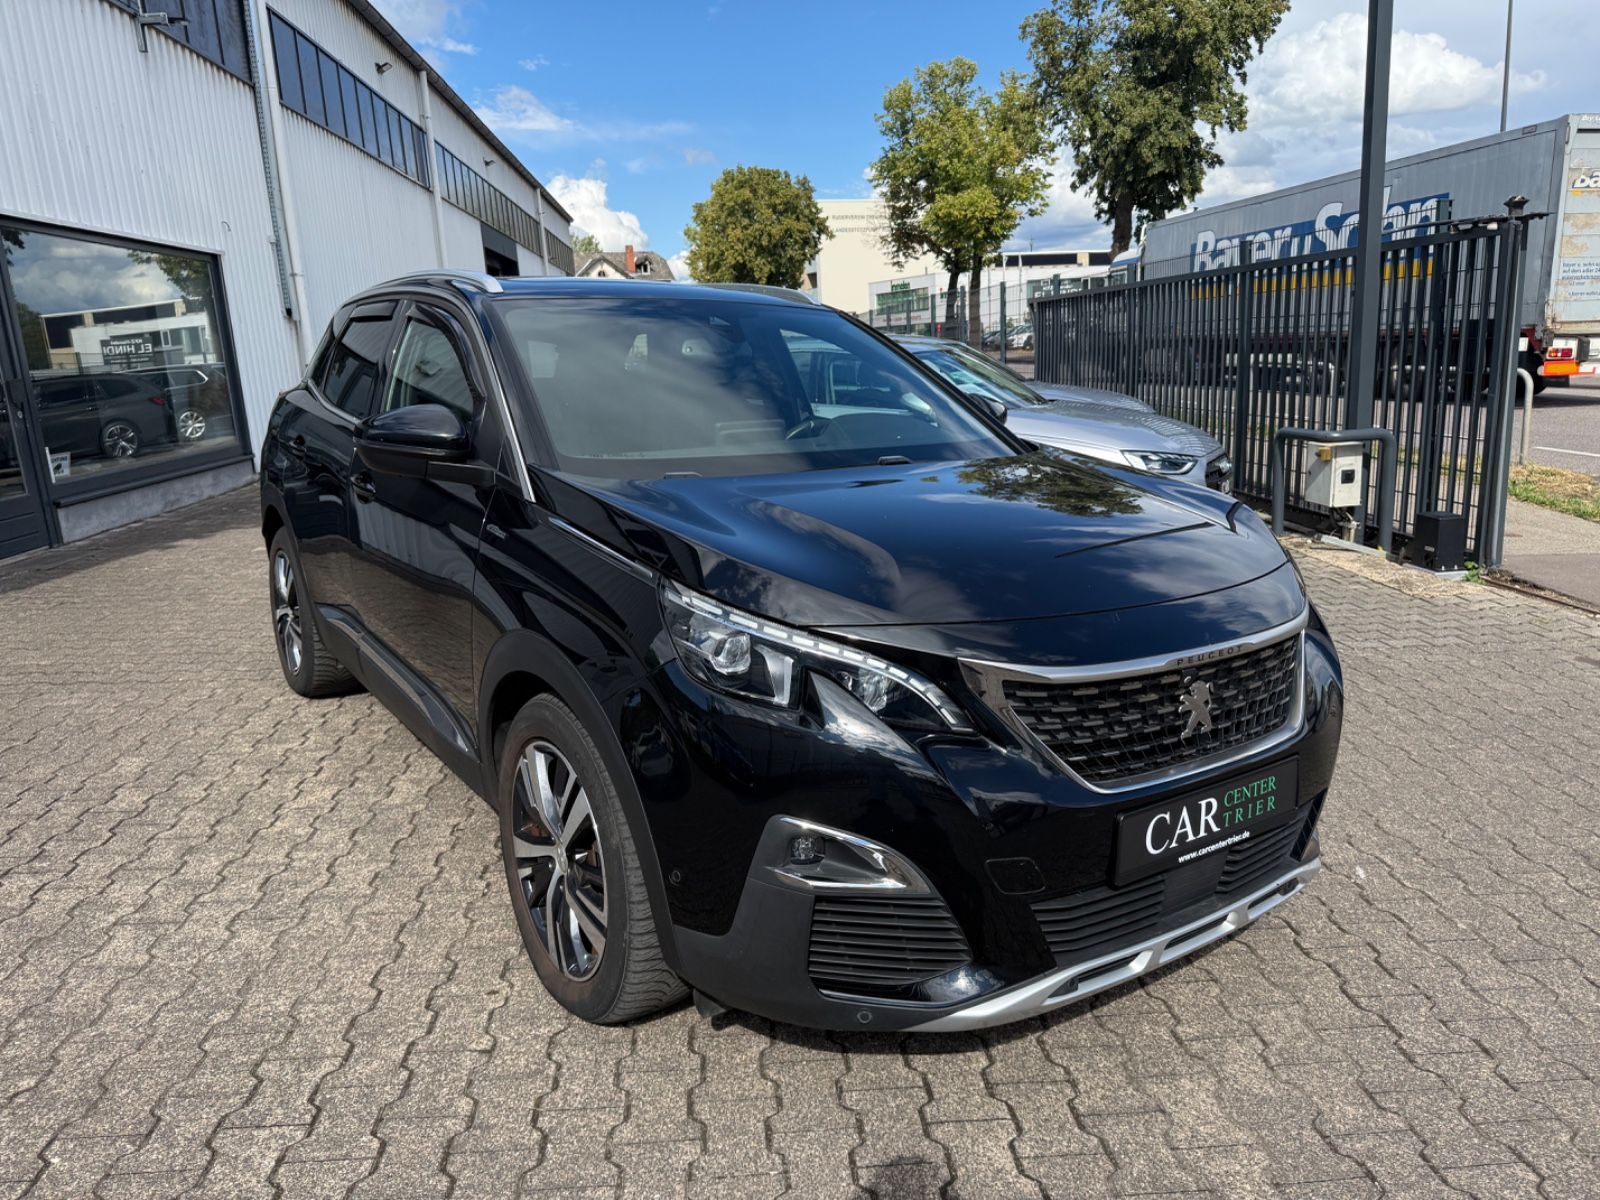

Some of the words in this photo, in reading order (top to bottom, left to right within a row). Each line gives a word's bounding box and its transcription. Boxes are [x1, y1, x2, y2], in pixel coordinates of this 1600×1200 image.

[1177, 645, 1242, 666] PEUGEOT
[1224, 775, 1277, 808] CENTER
[1145, 797, 1221, 855] CAR
[1223, 796, 1276, 828] TRIER
[1178, 830, 1251, 864] www.carcentertrier.de
